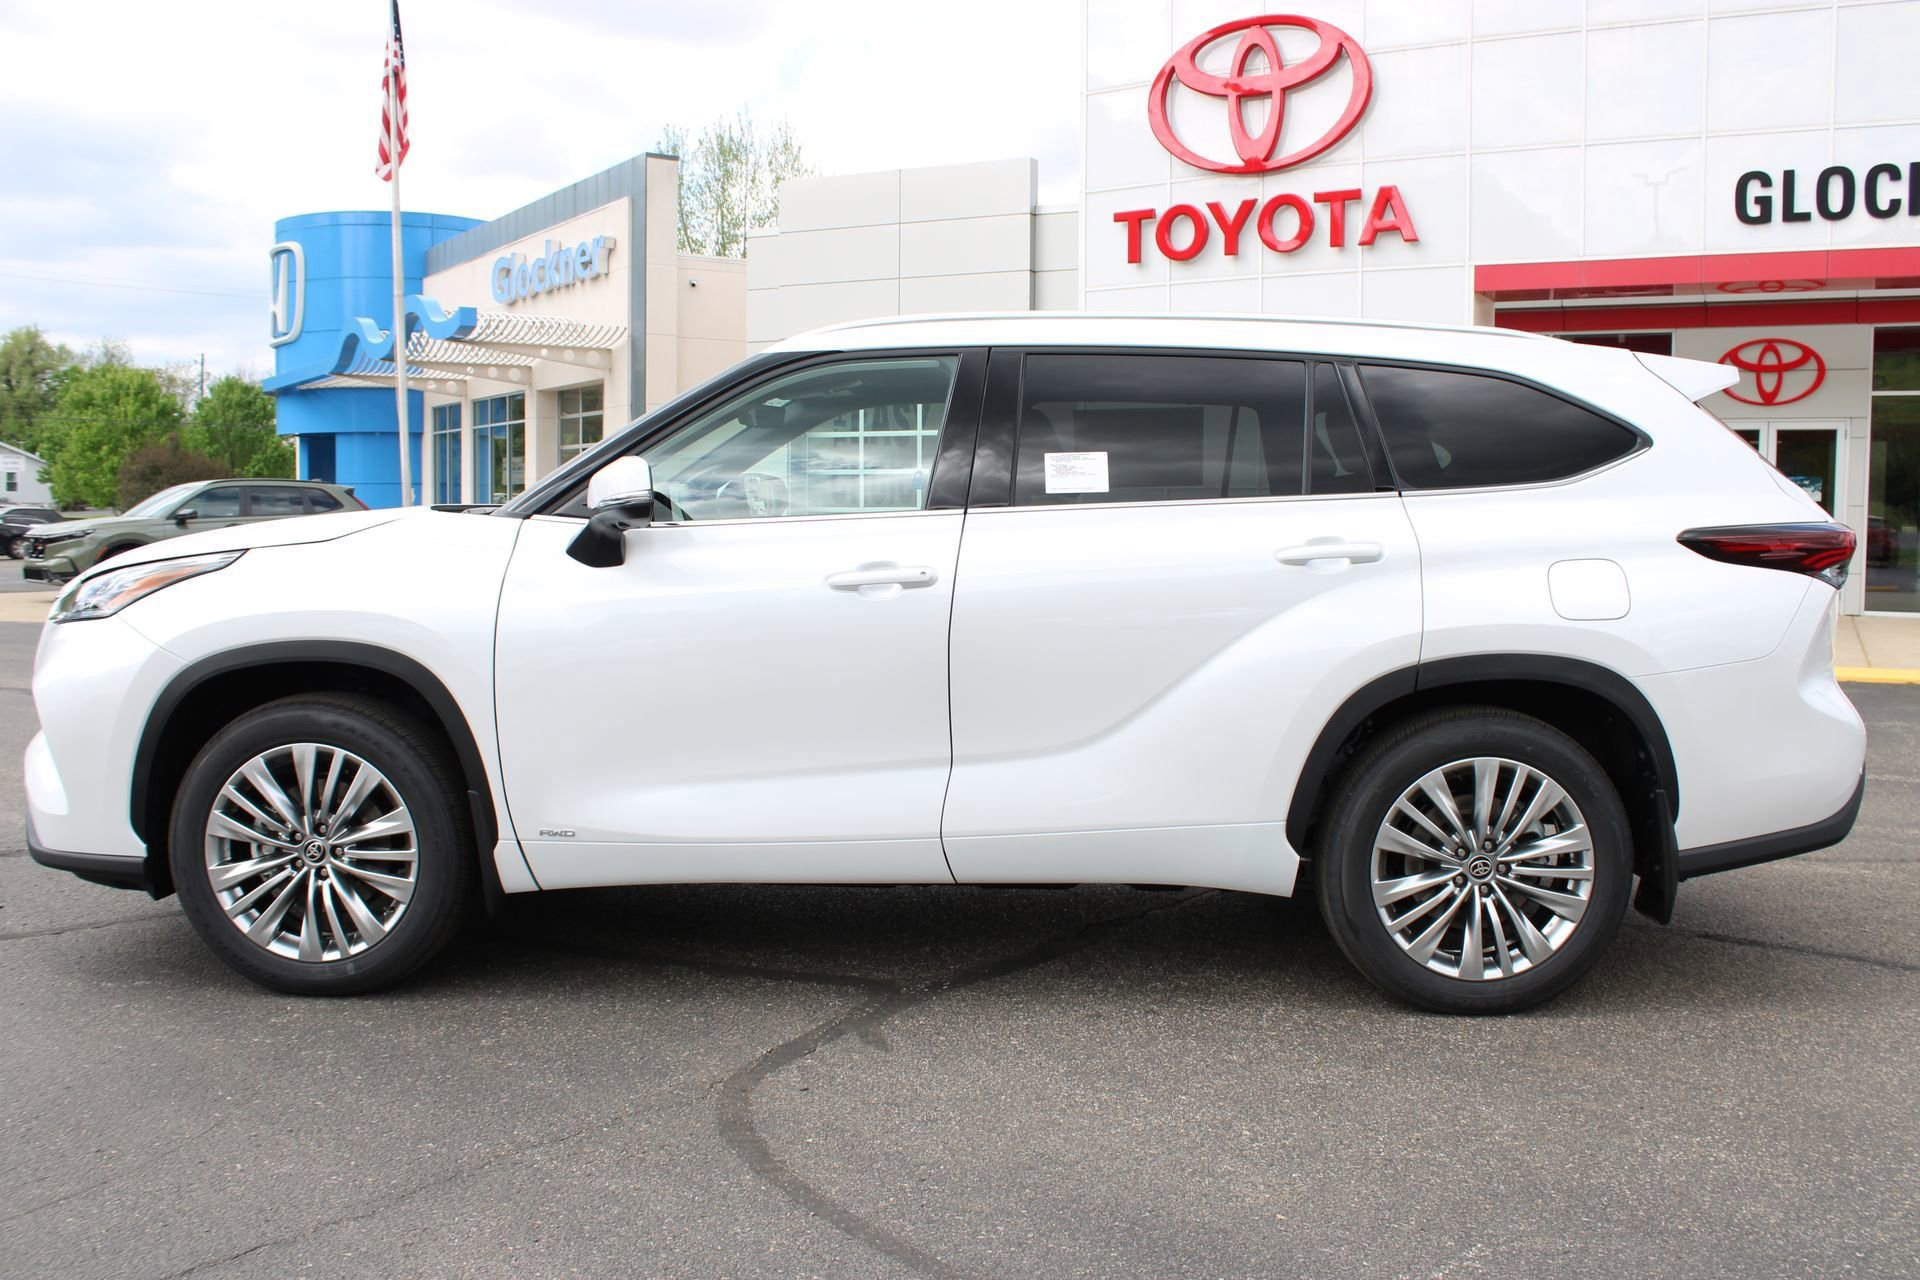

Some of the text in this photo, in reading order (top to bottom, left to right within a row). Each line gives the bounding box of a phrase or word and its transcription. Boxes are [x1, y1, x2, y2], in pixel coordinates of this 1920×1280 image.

[1113, 185, 1418, 264] TOYOTA
[491, 235, 614, 304] Glockner
[539, 829, 576, 838] AWD
